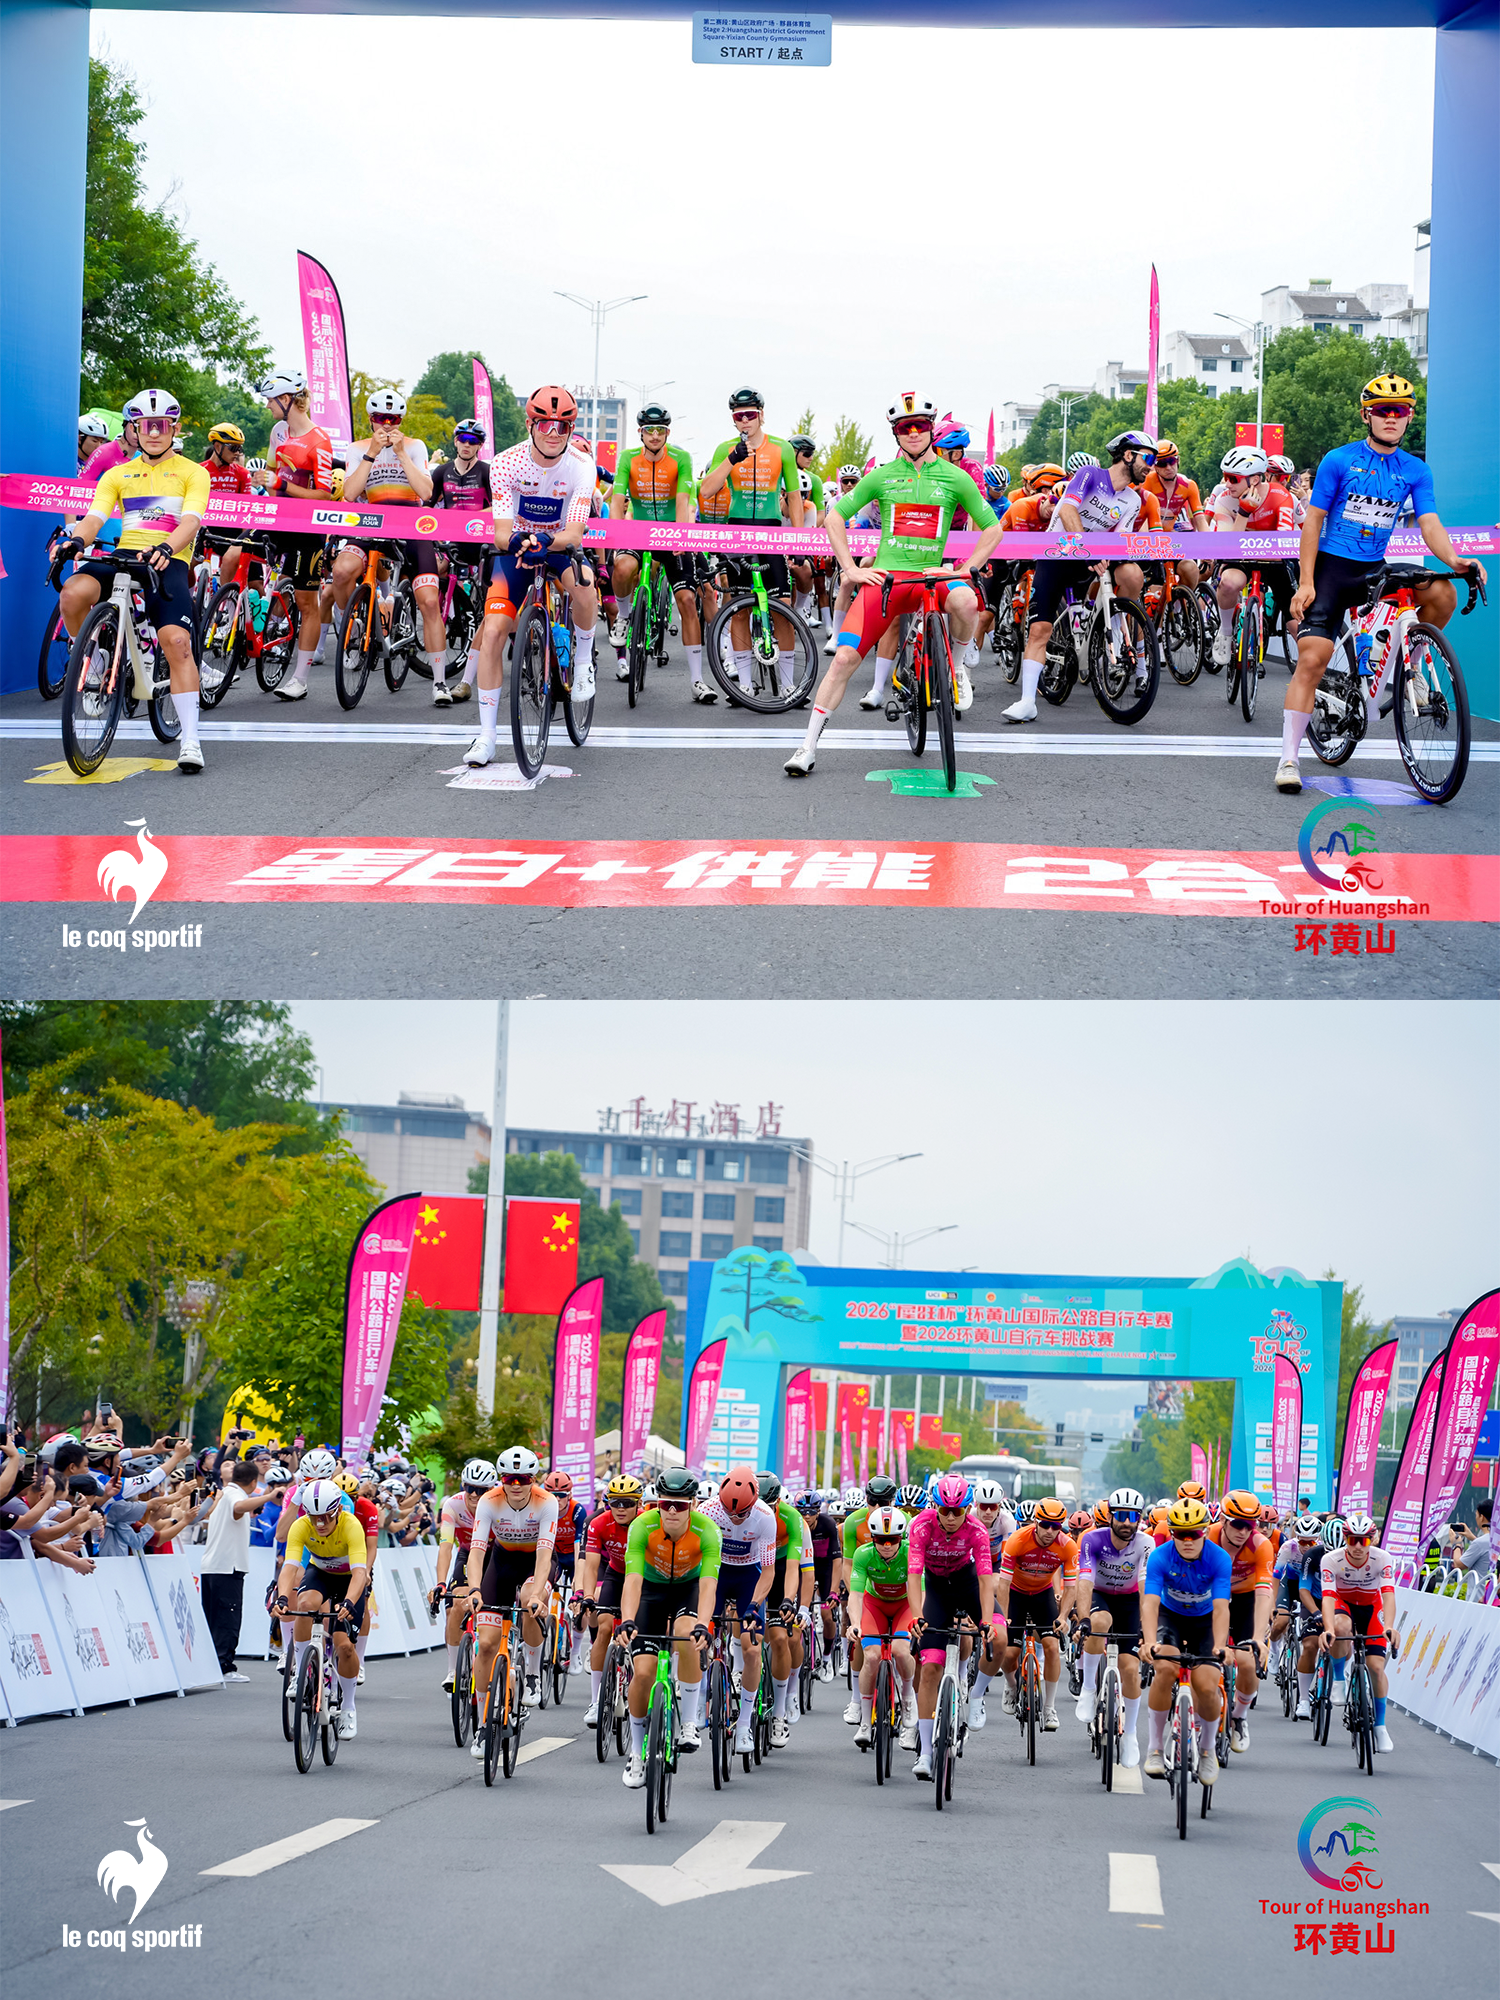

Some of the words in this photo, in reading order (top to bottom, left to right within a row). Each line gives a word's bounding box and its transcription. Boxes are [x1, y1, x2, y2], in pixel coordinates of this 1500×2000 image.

[703, 26, 721, 35] Stage
[720, 46, 764, 58] START
[778, 48, 804, 60] 起点
[208, 498, 278, 515] 路自行车赛
[524, 502, 557, 511] ROOJAI
[203, 512, 238, 522] GSHAN
[316, 512, 343, 524] UCI
[1278, 506, 1294, 530] NTA
[918, 542, 940, 552] sportif
[1120, 534, 1172, 548] TOUR
[792, 545, 857, 553] HUANGSN
[1410, 766, 1442, 793] NOVATEC
[226, 848, 936, 890] 蛋白+供能
[364, 1271, 387, 1386] 国际公路自行车赛
[900, 1324, 1115, 1348] 暨2026环黄山自行车挑战赛
[933, 1346, 976, 1354] HUANGSHAN
[1250, 1336, 1301, 1355] TOUR
[478, 1616, 502, 1625] ENG
